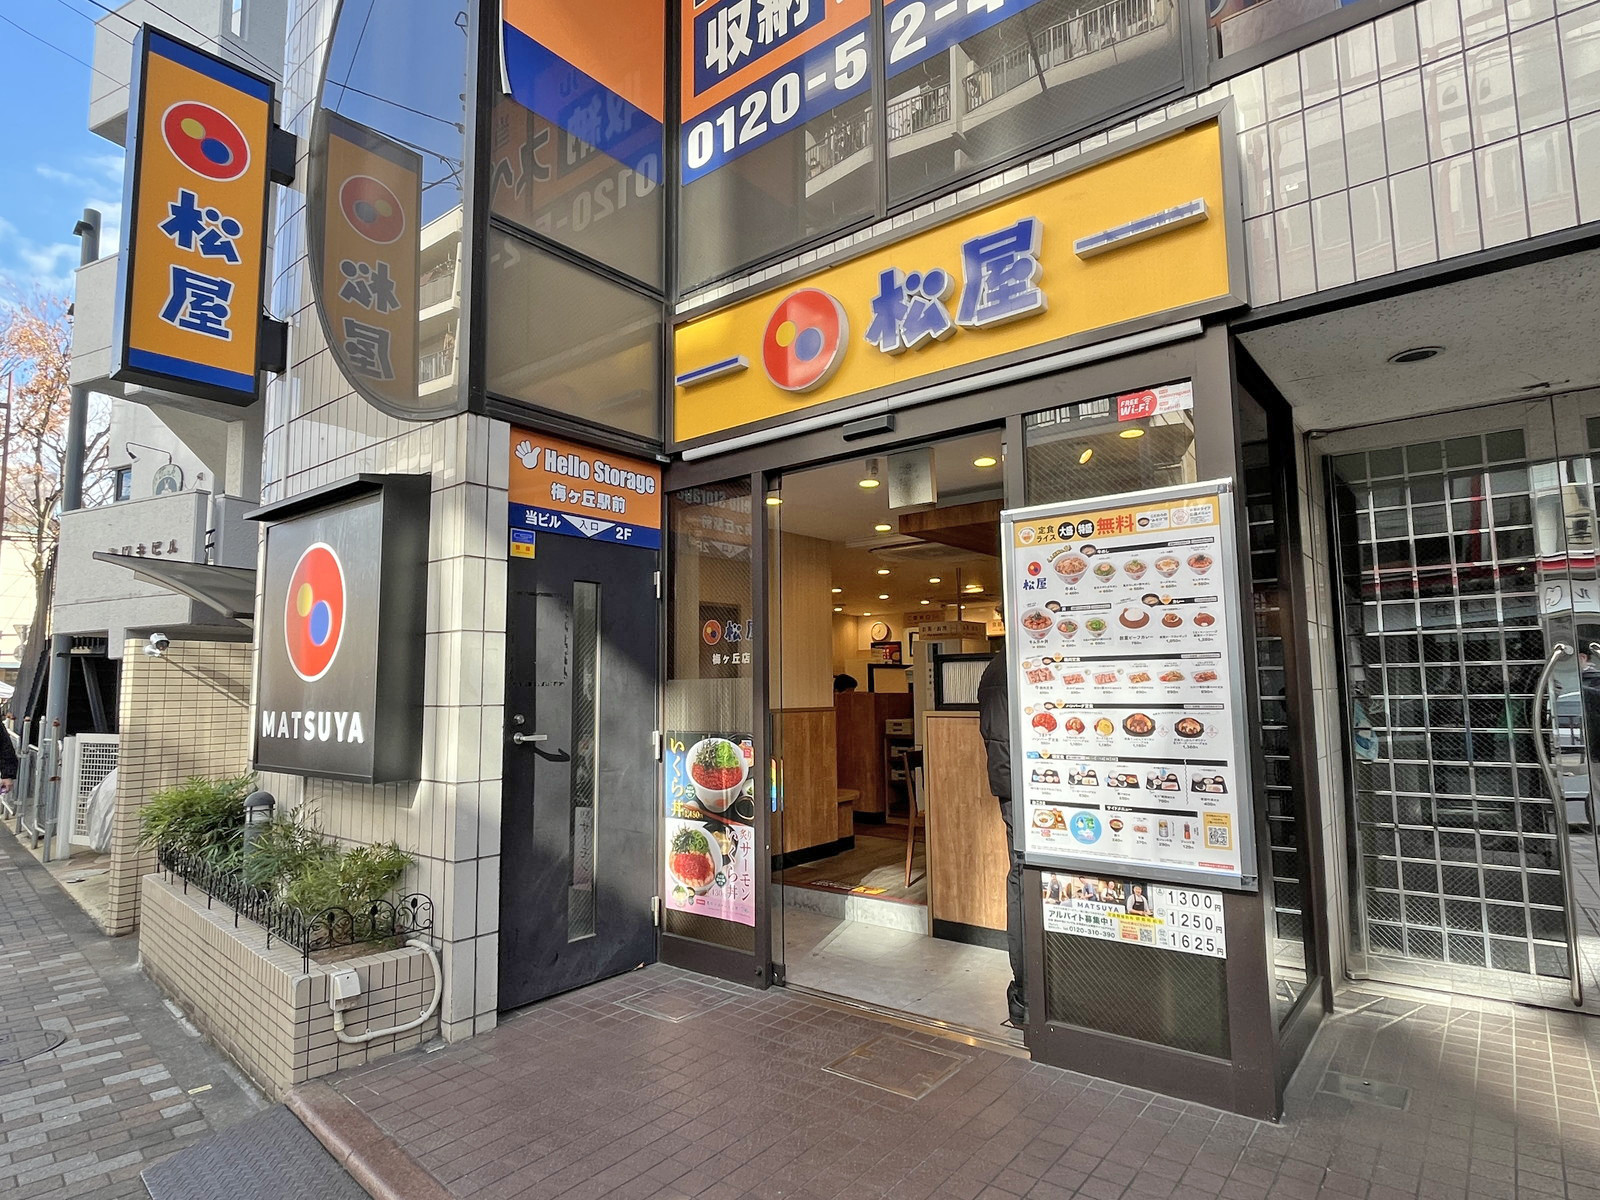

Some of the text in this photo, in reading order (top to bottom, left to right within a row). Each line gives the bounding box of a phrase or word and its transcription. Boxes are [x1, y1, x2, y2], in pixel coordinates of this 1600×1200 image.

[158, 187, 243, 341] 松屋
[864, 216, 1048, 355] 松屋
[1120, 398, 1139, 407] FREE
[1120, 402, 1149, 416] Wi-Fi
[544, 448, 655, 494] Hello Storage
[550, 482, 627, 514] 梅ヶ丘駅前
[525, 510, 632, 541] 当ビル 入口 2F
[1038, 525, 1054, 534] 定食
[1059, 525, 1074, 537] 大盛
[1097, 513, 1134, 536] 無料
[1037, 534, 1056, 543] ライス
[1023, 578, 1047, 590] 松屋
[712, 653, 751, 666] 梅ヶ丘店
[262, 711, 364, 744] MATSUYA
[670, 738, 685, 817] いくら丼
[726, 827, 739, 900] いくら丼
[740, 829, 752, 901] 炙りサーモン
[1077, 902, 1119, 912] MATSUYA
[1069, 926, 1115, 938] 0120-310-390
